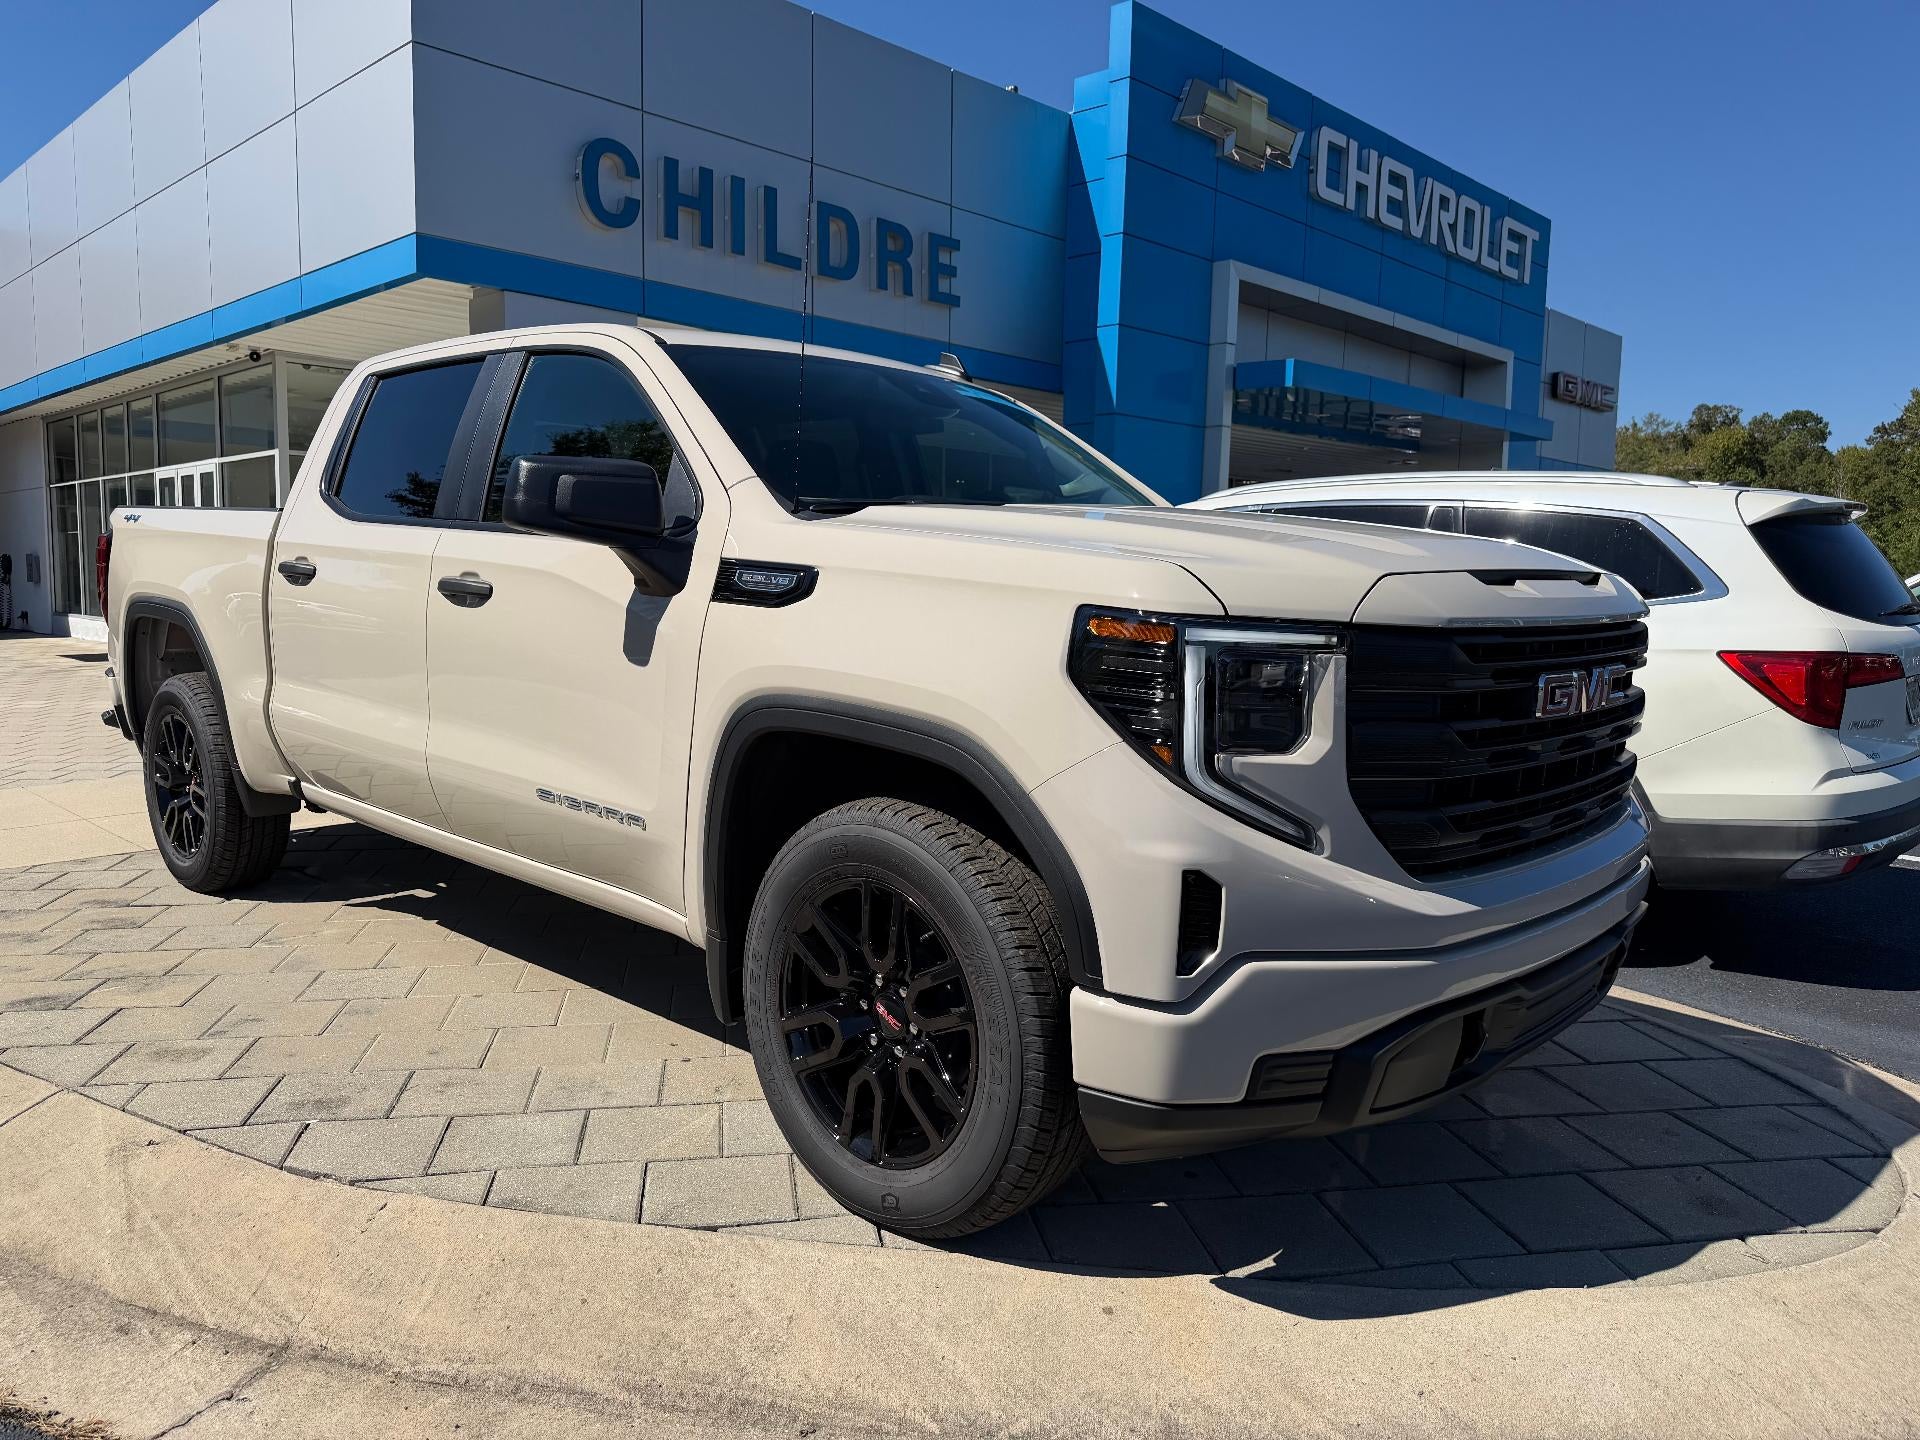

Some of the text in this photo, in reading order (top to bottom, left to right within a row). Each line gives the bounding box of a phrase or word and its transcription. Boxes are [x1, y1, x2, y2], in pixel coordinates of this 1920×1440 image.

[575, 137, 961, 308] CHILDRE
[1311, 126, 1540, 285] CHEVROLET
[1552, 371, 1617, 412] GMC
[1536, 664, 1627, 718] GMC
[535, 787, 647, 832] SIERRA
[876, 1001, 902, 1030] GMC
